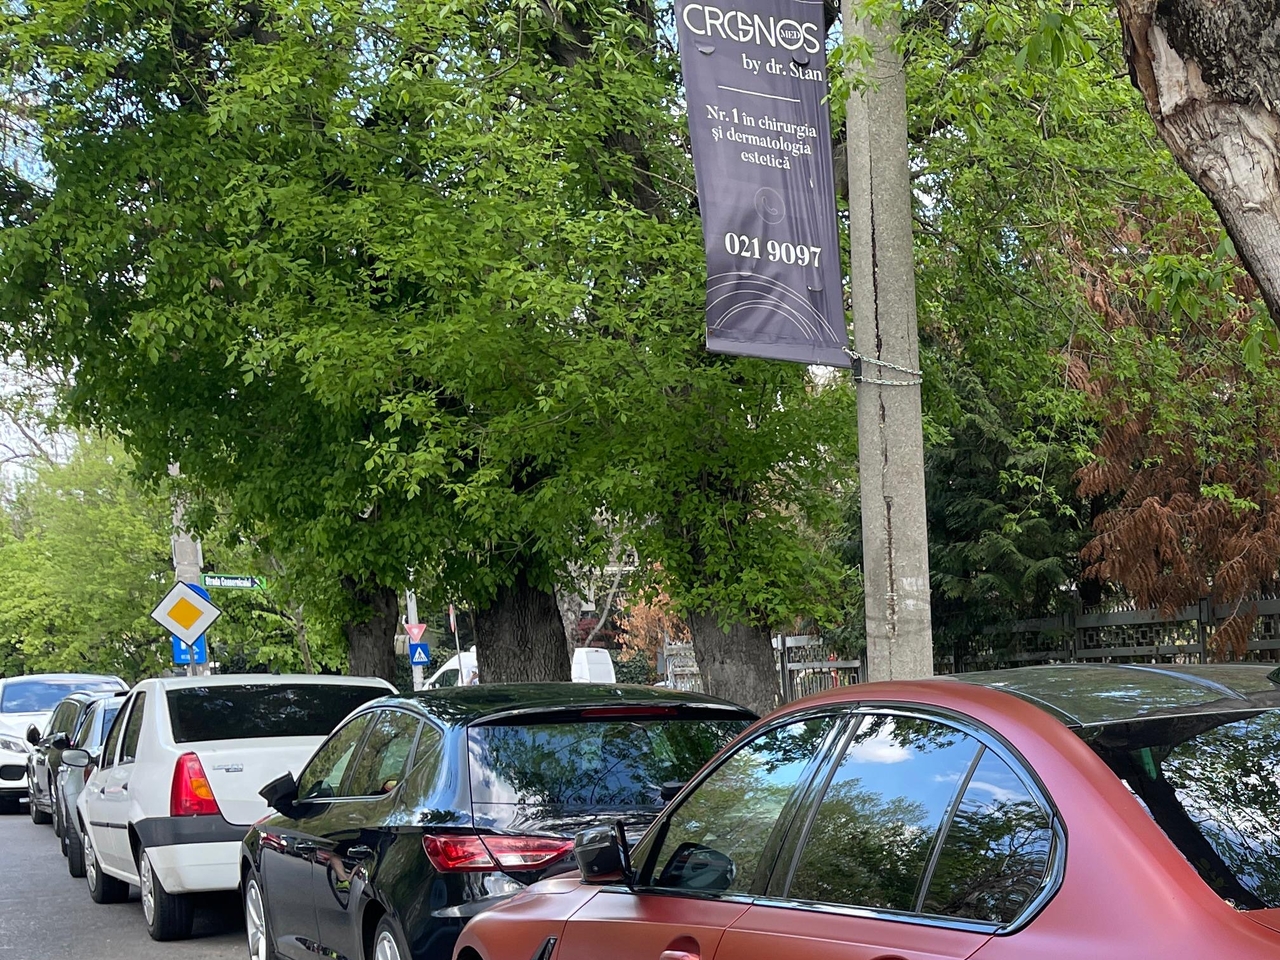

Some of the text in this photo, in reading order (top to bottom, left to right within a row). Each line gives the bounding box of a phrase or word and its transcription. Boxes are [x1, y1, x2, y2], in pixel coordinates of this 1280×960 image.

[780, 29, 800, 40] MED
[742, 53, 823, 82] by dr. Stan
[705, 104, 817, 140] Nr. 1 în chirurgia
[726, 126, 812, 157] dermatologia
[740, 151, 791, 170] estetică
[724, 232, 822, 268] 021 9097
